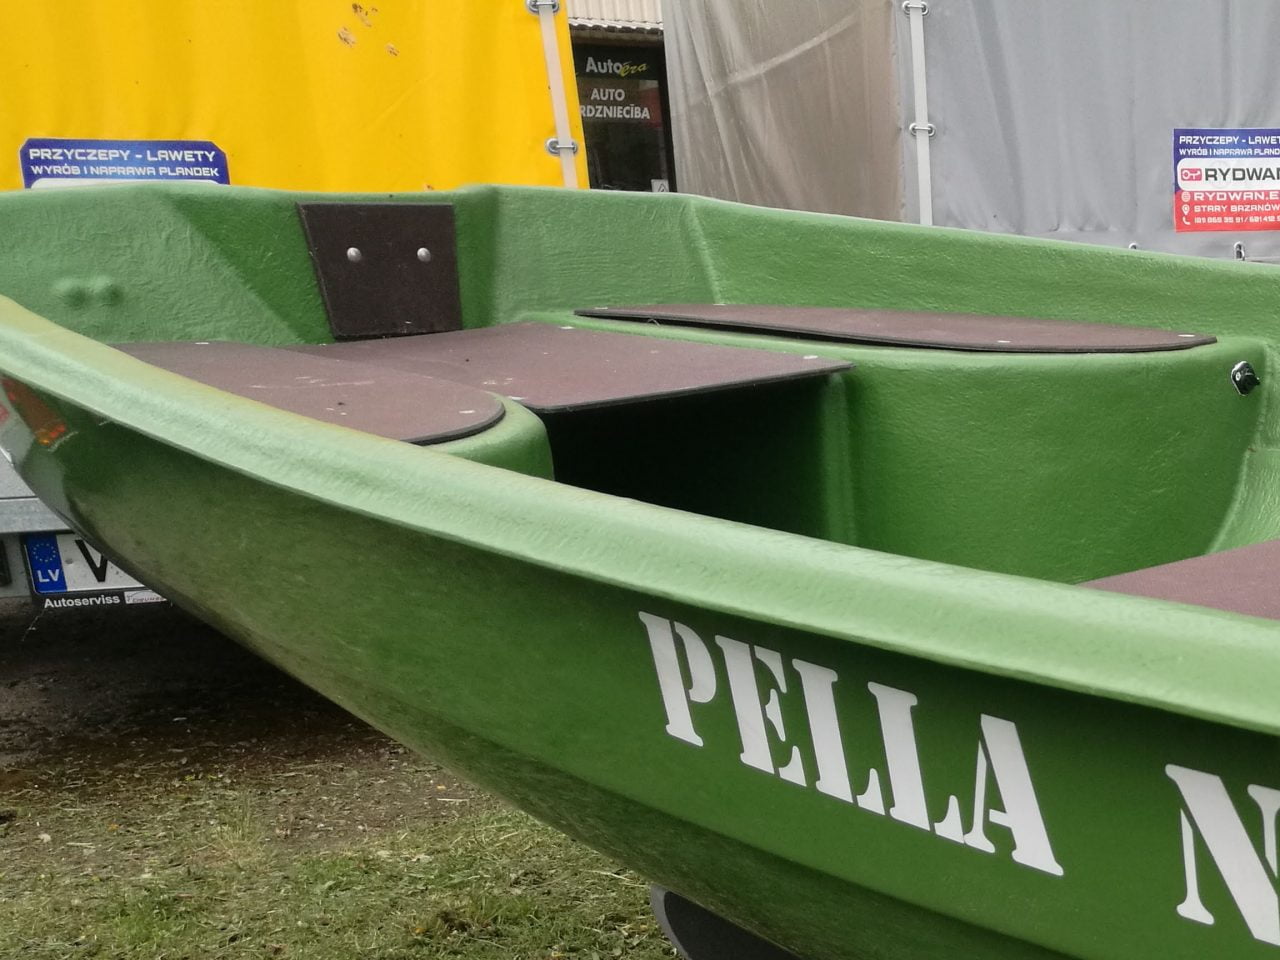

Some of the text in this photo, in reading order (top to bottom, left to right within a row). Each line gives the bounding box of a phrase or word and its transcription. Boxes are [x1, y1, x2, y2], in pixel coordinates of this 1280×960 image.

[590, 88, 626, 101] AUTO
[580, 104, 650, 119] RDZNIECĪBA
[1179, 135, 1239, 145] PRZYCZEPY
[29, 148, 130, 161] PRZYCZEPY
[147, 150, 215, 162] LAWETY
[1179, 147, 1208, 156] WYRÓB
[1213, 148, 1253, 156] NAPRAWA
[31, 163, 81, 175] WYRÓB
[90, 166, 155, 176] NAPRAWA
[159, 166, 220, 177] PLANDEK
[1193, 205, 1227, 213] STARY
[36, 568, 60, 583] LV
[44, 594, 121, 609] Autoserviss
[637, 610, 1065, 877] PELLA
